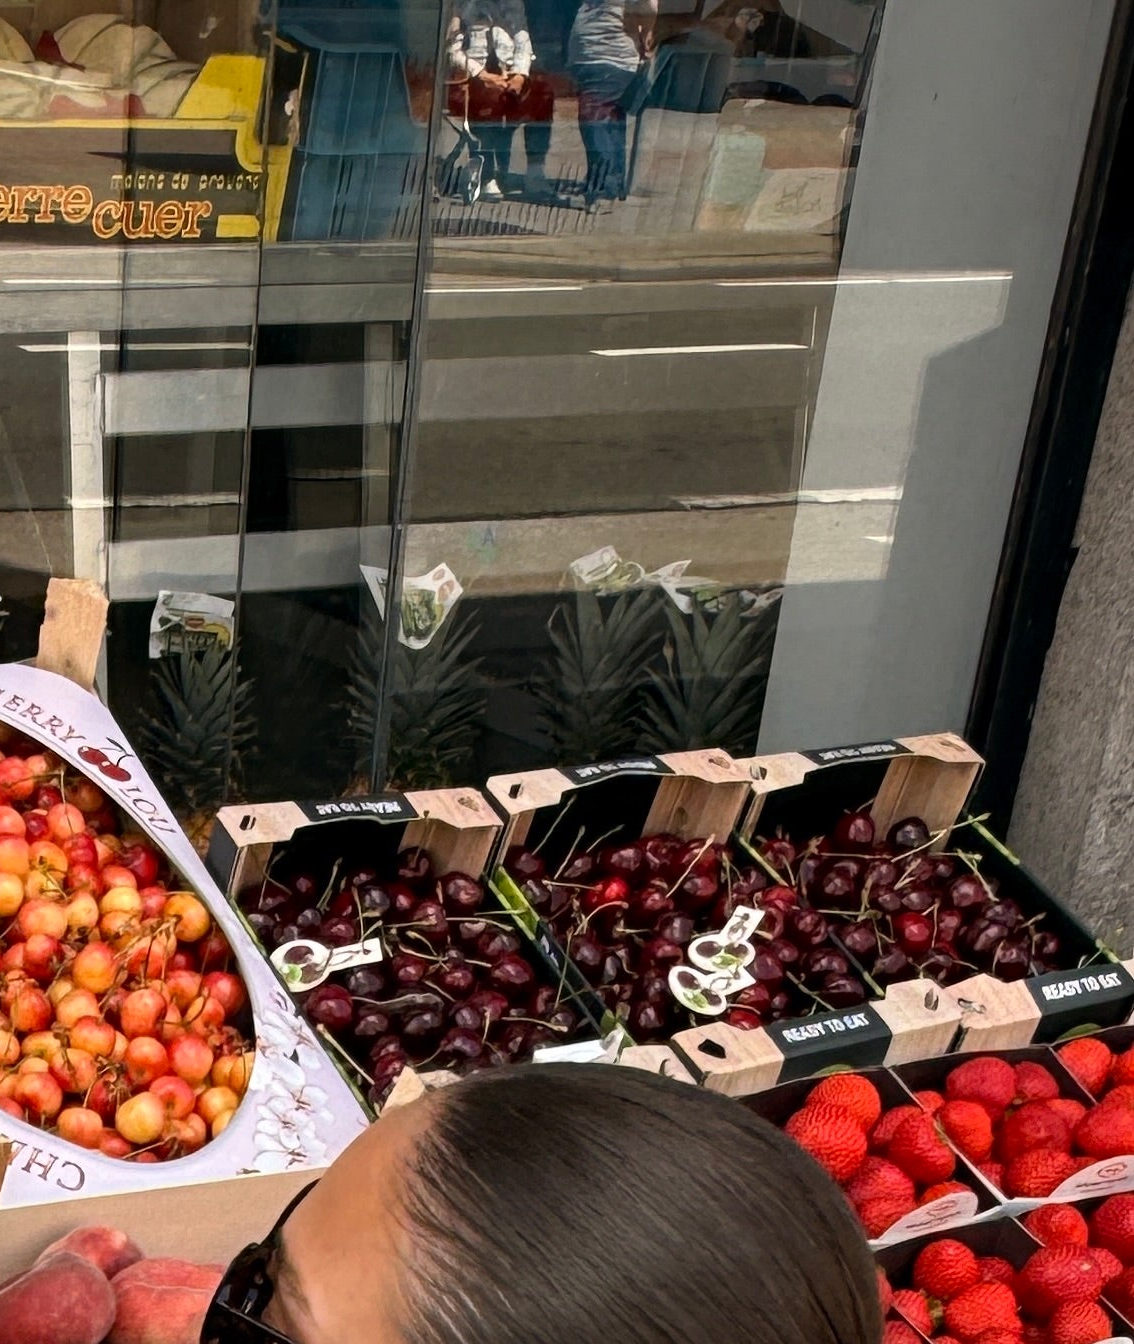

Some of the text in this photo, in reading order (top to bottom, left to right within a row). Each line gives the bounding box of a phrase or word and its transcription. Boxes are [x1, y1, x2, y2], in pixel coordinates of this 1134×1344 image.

[92, 198, 212, 240] cuer
[119, 786, 178, 835] LOU
[1041, 972, 1122, 1001] READY TO EAT
[781, 1012, 870, 1043] READY TO EAT
